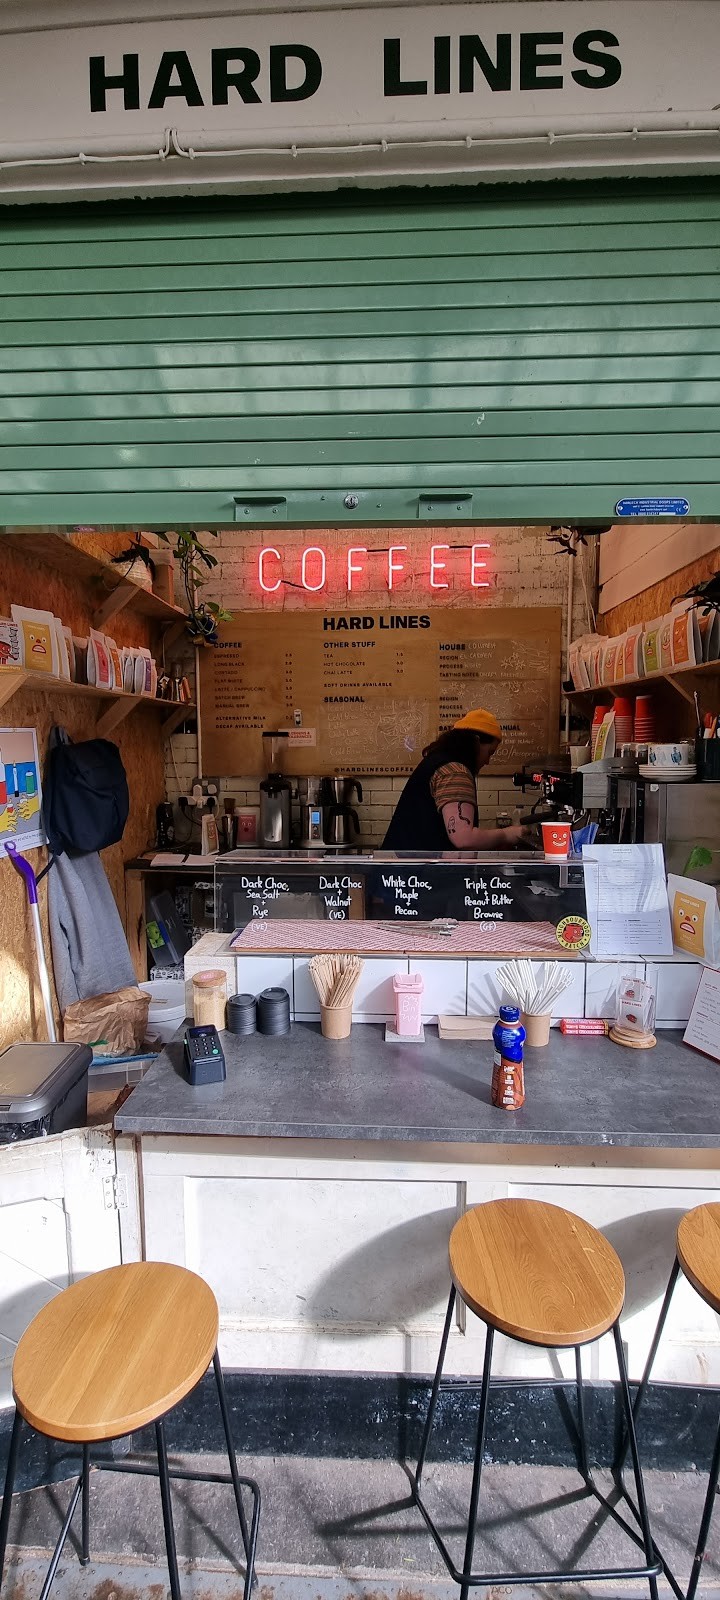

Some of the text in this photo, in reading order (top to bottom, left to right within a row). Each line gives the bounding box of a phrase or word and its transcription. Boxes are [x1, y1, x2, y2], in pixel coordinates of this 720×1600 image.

[88, 29, 622, 113] HARD LINES
[258, 543, 491, 592] COFFEE
[323, 615, 431, 631] HARD LINES
[241, 876, 262, 889] Dark
[319, 876, 362, 889] Dark Choc
[382, 875, 406, 888] White
[464, 877, 512, 894] Triple Choc
[246, 889, 280, 899] Sea Salt
[395, 888, 419, 902] Maple
[464, 894, 514, 906] Peanut Butter
[324, 896, 352, 907] Walnut
[252, 905, 268, 919] Rye
[328, 909, 346, 921] (VE)
[395, 905, 418, 916] Pecan
[474, 907, 504, 919] Brownie
